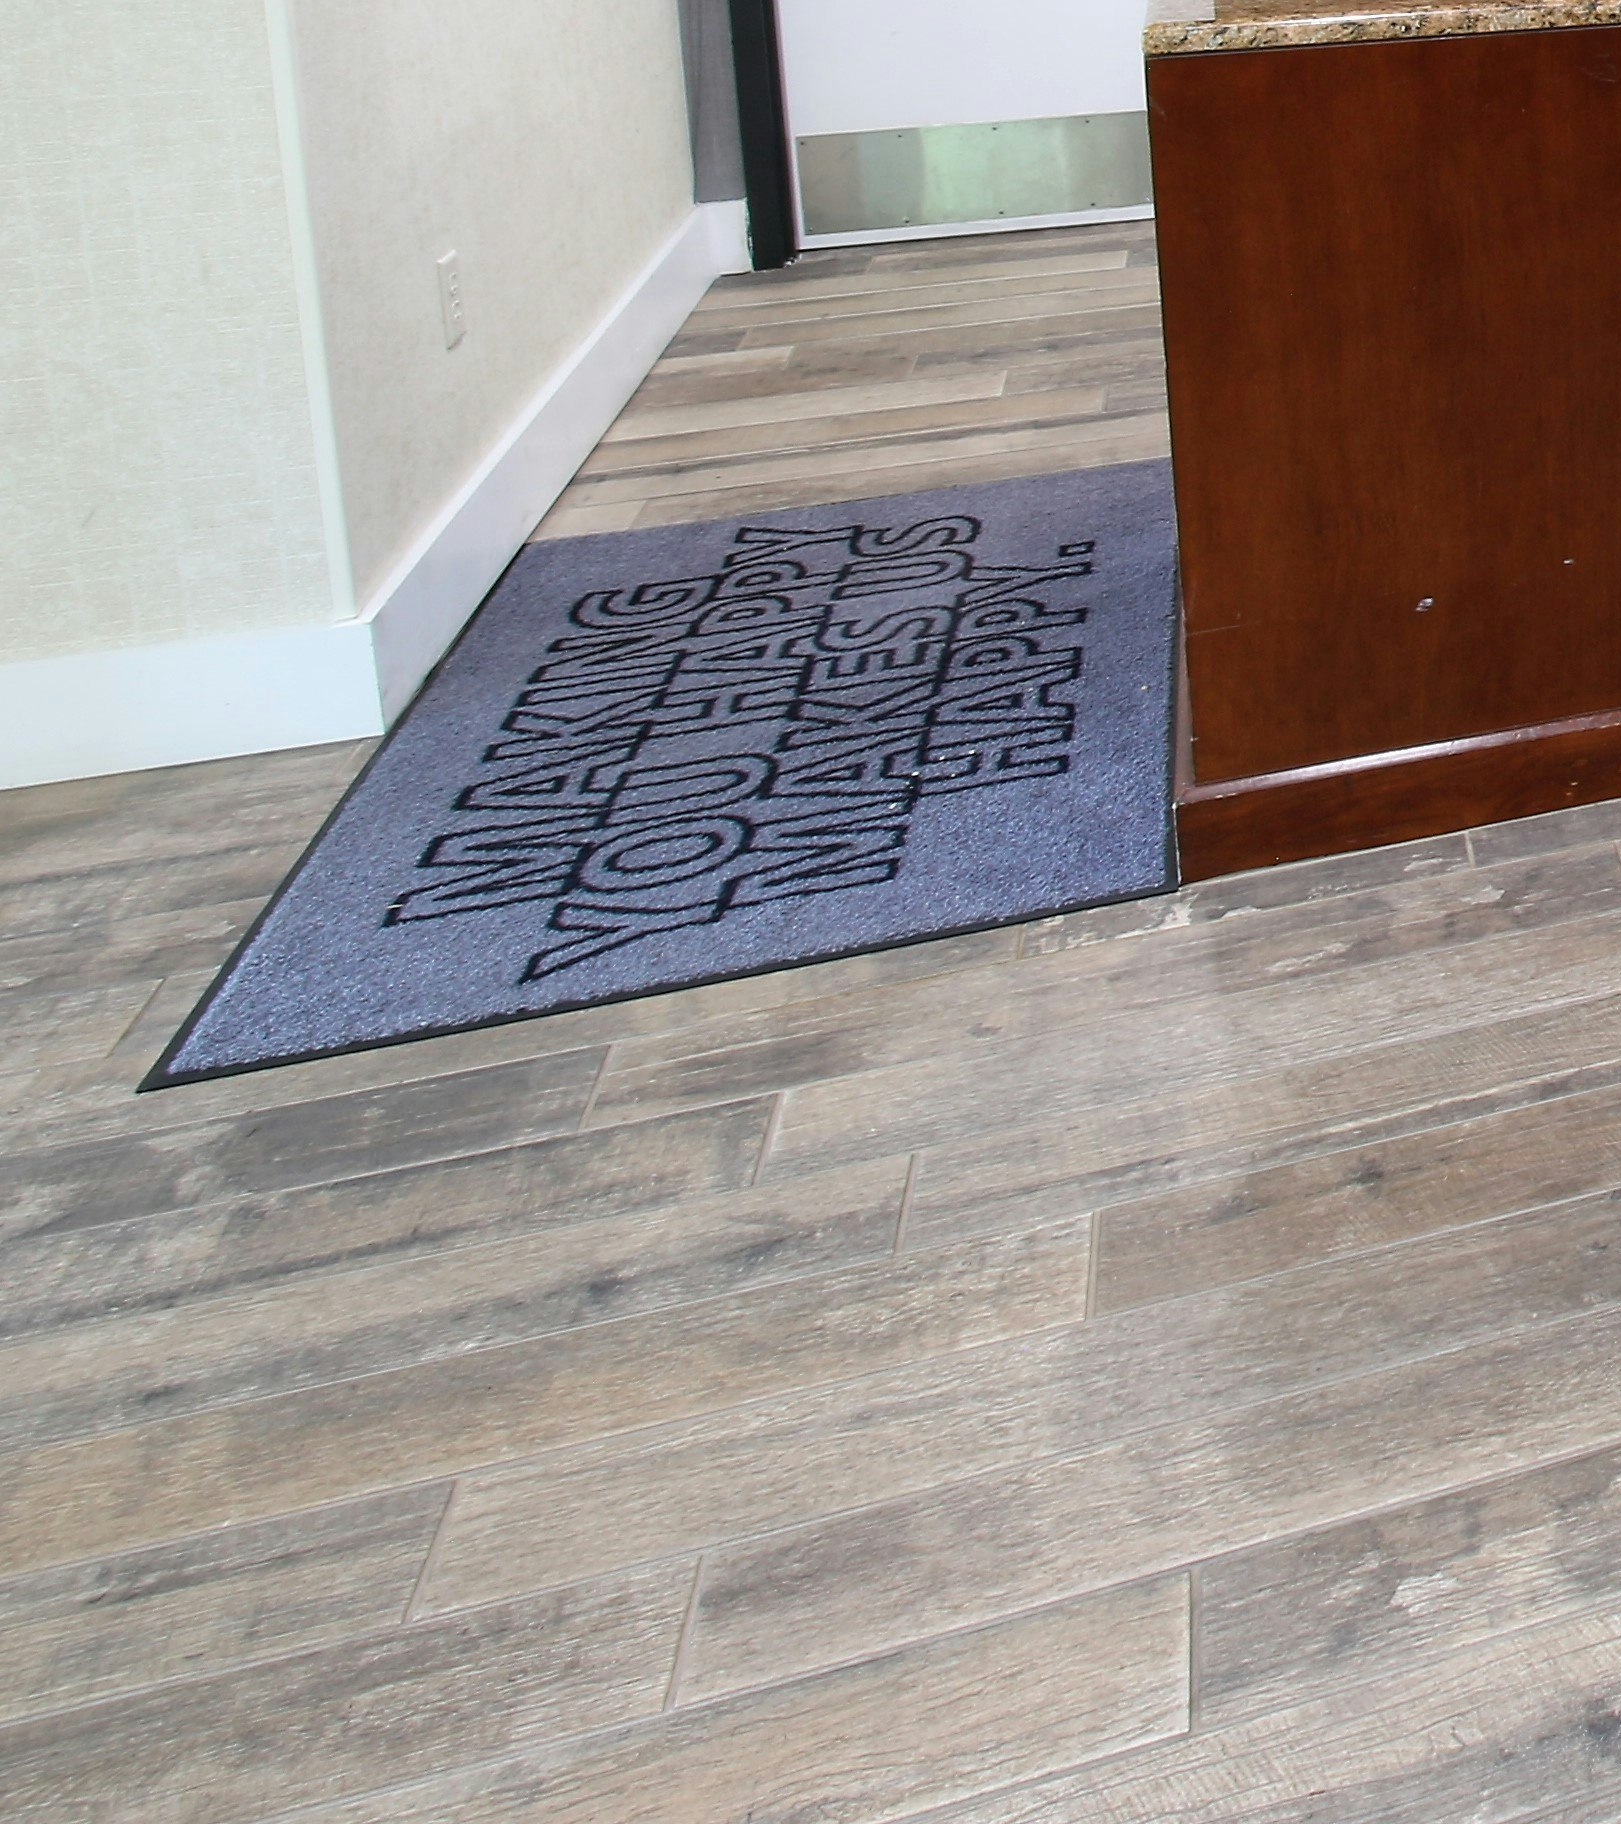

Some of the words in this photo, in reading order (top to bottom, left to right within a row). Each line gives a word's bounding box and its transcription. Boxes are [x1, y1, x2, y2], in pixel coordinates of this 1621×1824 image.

[640, 525, 865, 739] HAPPY
[830, 516, 982, 600] US
[916, 541, 1096, 798] HAPPY.
[380, 575, 719, 928] MAKING
[519, 753, 779, 985] YOU
[715, 606, 960, 912] MAKES
